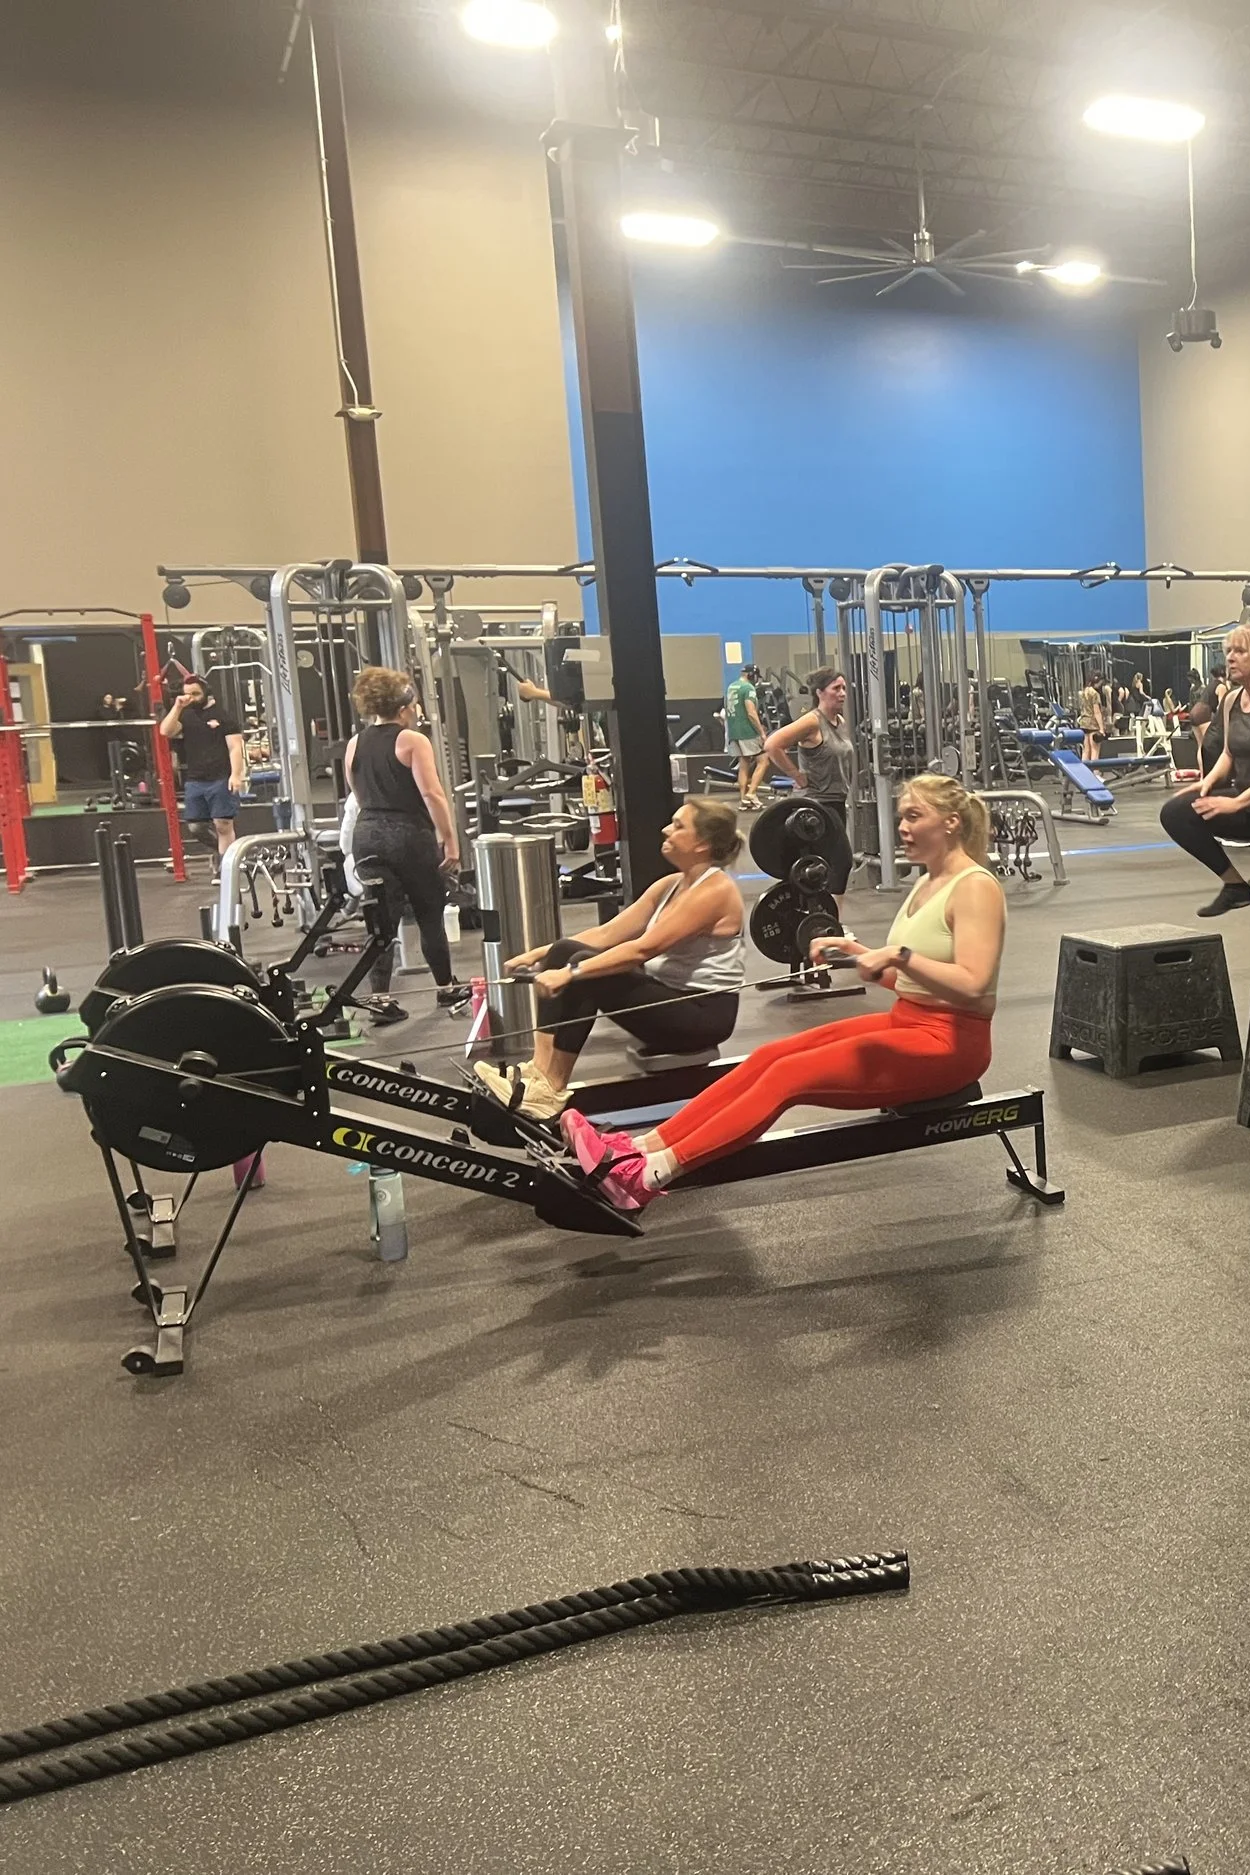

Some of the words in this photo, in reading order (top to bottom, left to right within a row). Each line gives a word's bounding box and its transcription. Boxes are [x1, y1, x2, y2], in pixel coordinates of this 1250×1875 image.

[336, 1069, 440, 1106] concept
[443, 1096, 459, 1110] 2
[376, 1140, 498, 1183] concept
[502, 1172, 520, 1188] 2
